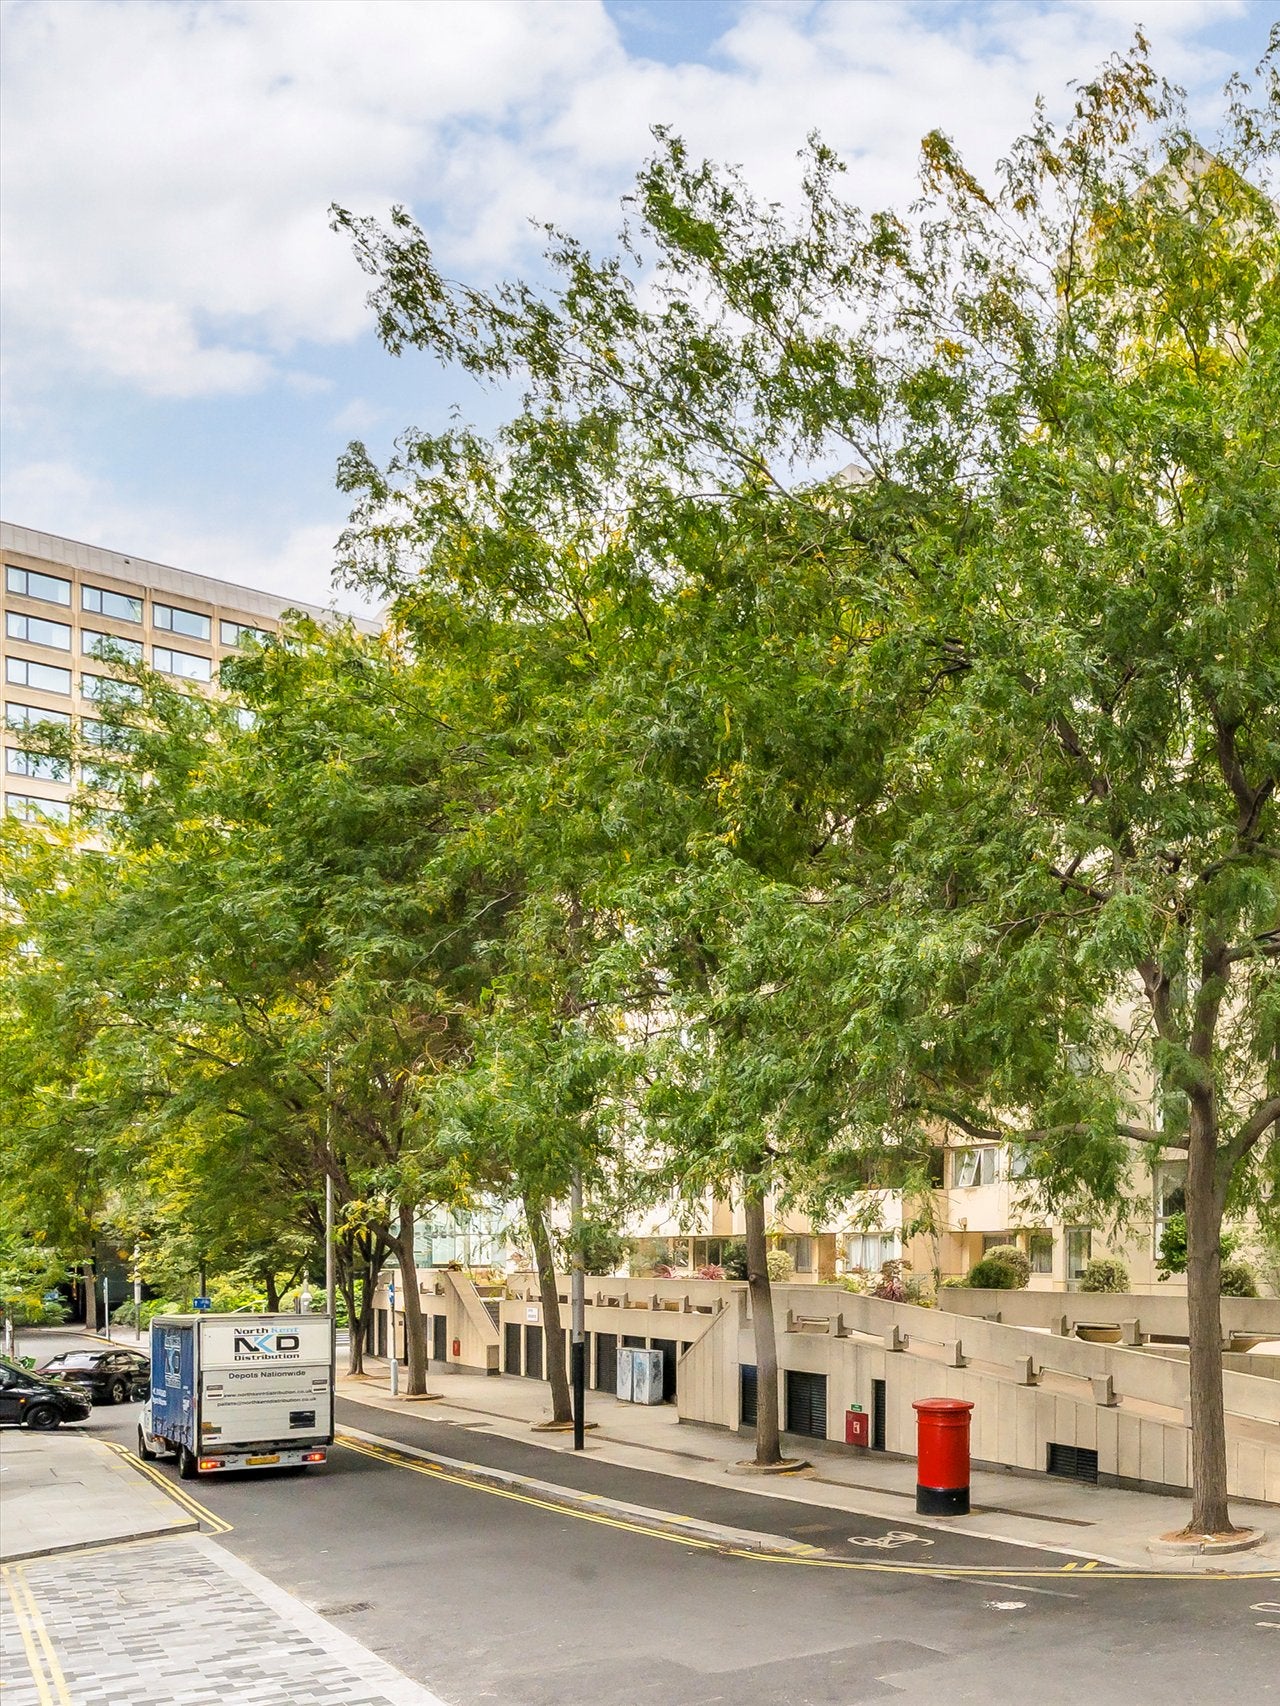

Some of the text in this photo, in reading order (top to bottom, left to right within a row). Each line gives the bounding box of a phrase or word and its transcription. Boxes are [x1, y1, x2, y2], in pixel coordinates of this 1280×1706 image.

[234, 1327, 269, 1335] North
[234, 1334, 300, 1353] NKD
[234, 1353, 300, 1361] Distribution
[228, 1370, 306, 1380] Depots Nationwide
